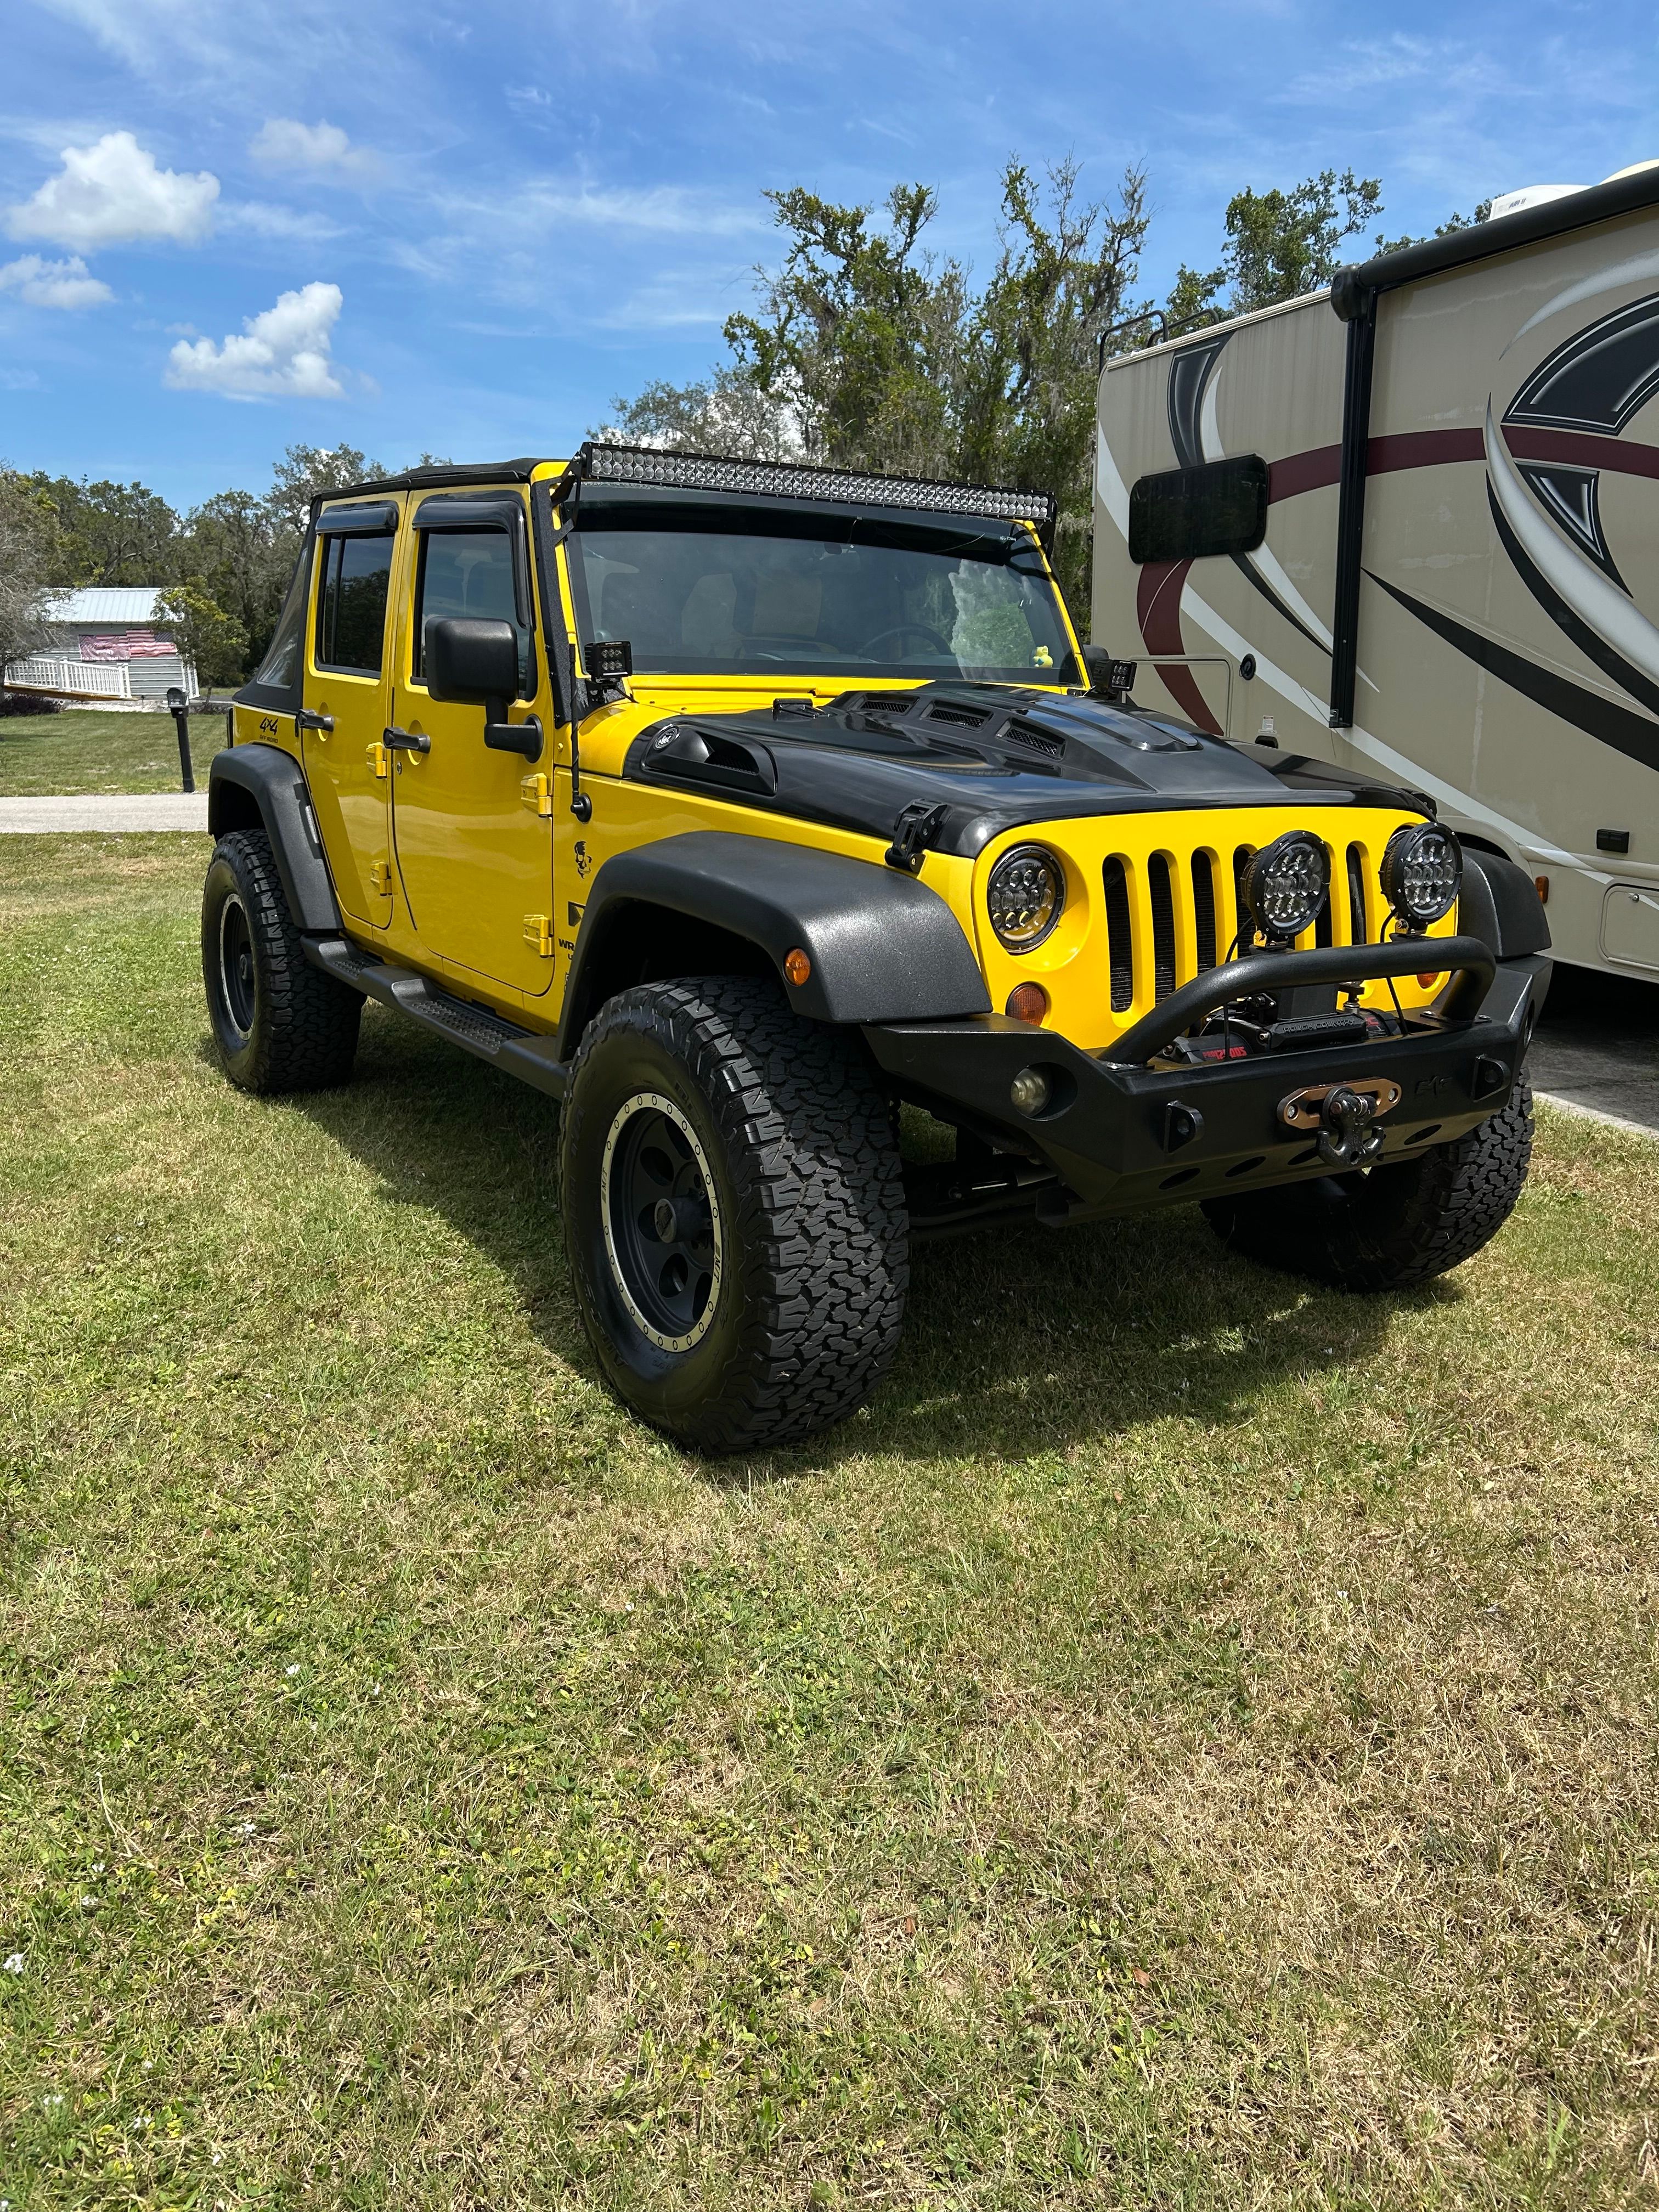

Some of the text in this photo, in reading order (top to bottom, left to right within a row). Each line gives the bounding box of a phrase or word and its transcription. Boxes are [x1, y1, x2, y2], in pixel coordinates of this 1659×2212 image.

[558, 938, 575, 951] WR
[1283, 1019, 1354, 1033] ROUGH COUNTRY
